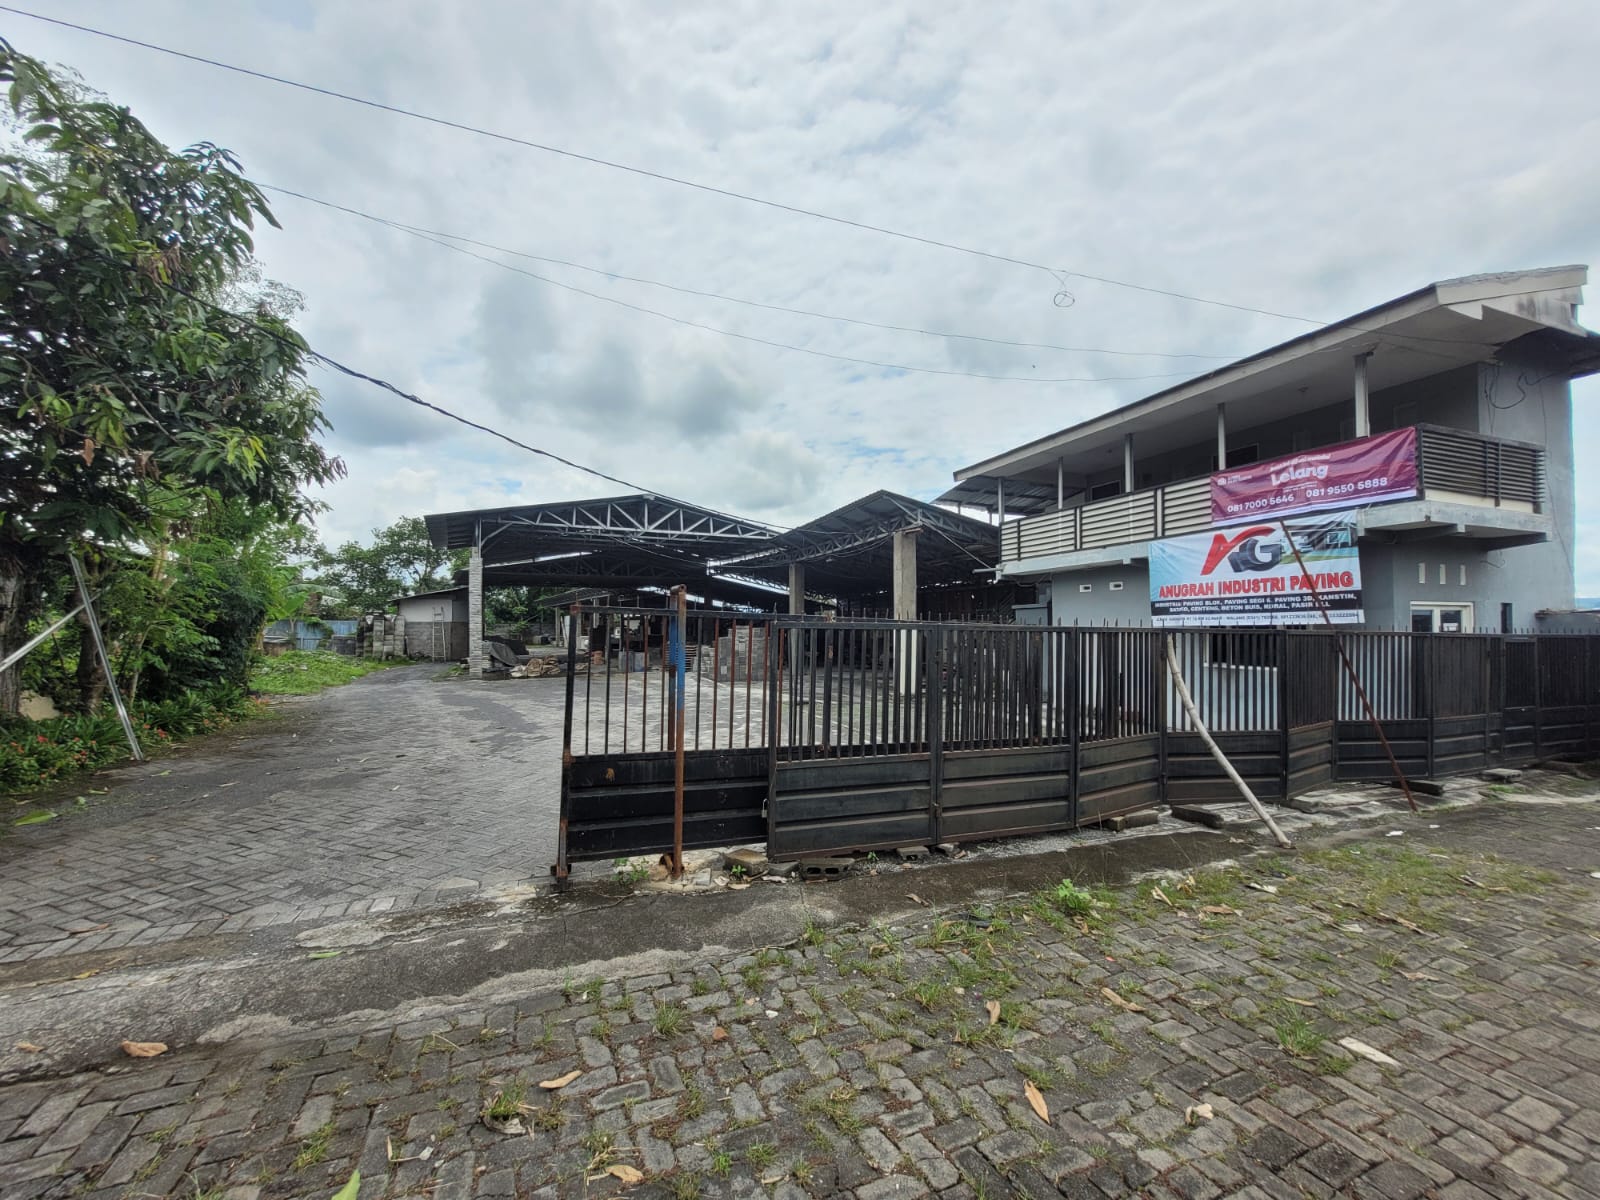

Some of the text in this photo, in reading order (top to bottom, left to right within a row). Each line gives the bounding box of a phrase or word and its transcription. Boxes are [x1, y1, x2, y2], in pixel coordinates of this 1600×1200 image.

[1270, 465, 1329, 487] Lelang
[1306, 488, 1325, 498] 081
[1327, 483, 1354, 495] 9550
[1357, 477, 1388, 490] 5888
[1227, 494, 1295, 513] 081 7000 5646
[1160, 571, 1354, 598] ANUGRAH INDUSTRI PAVING
